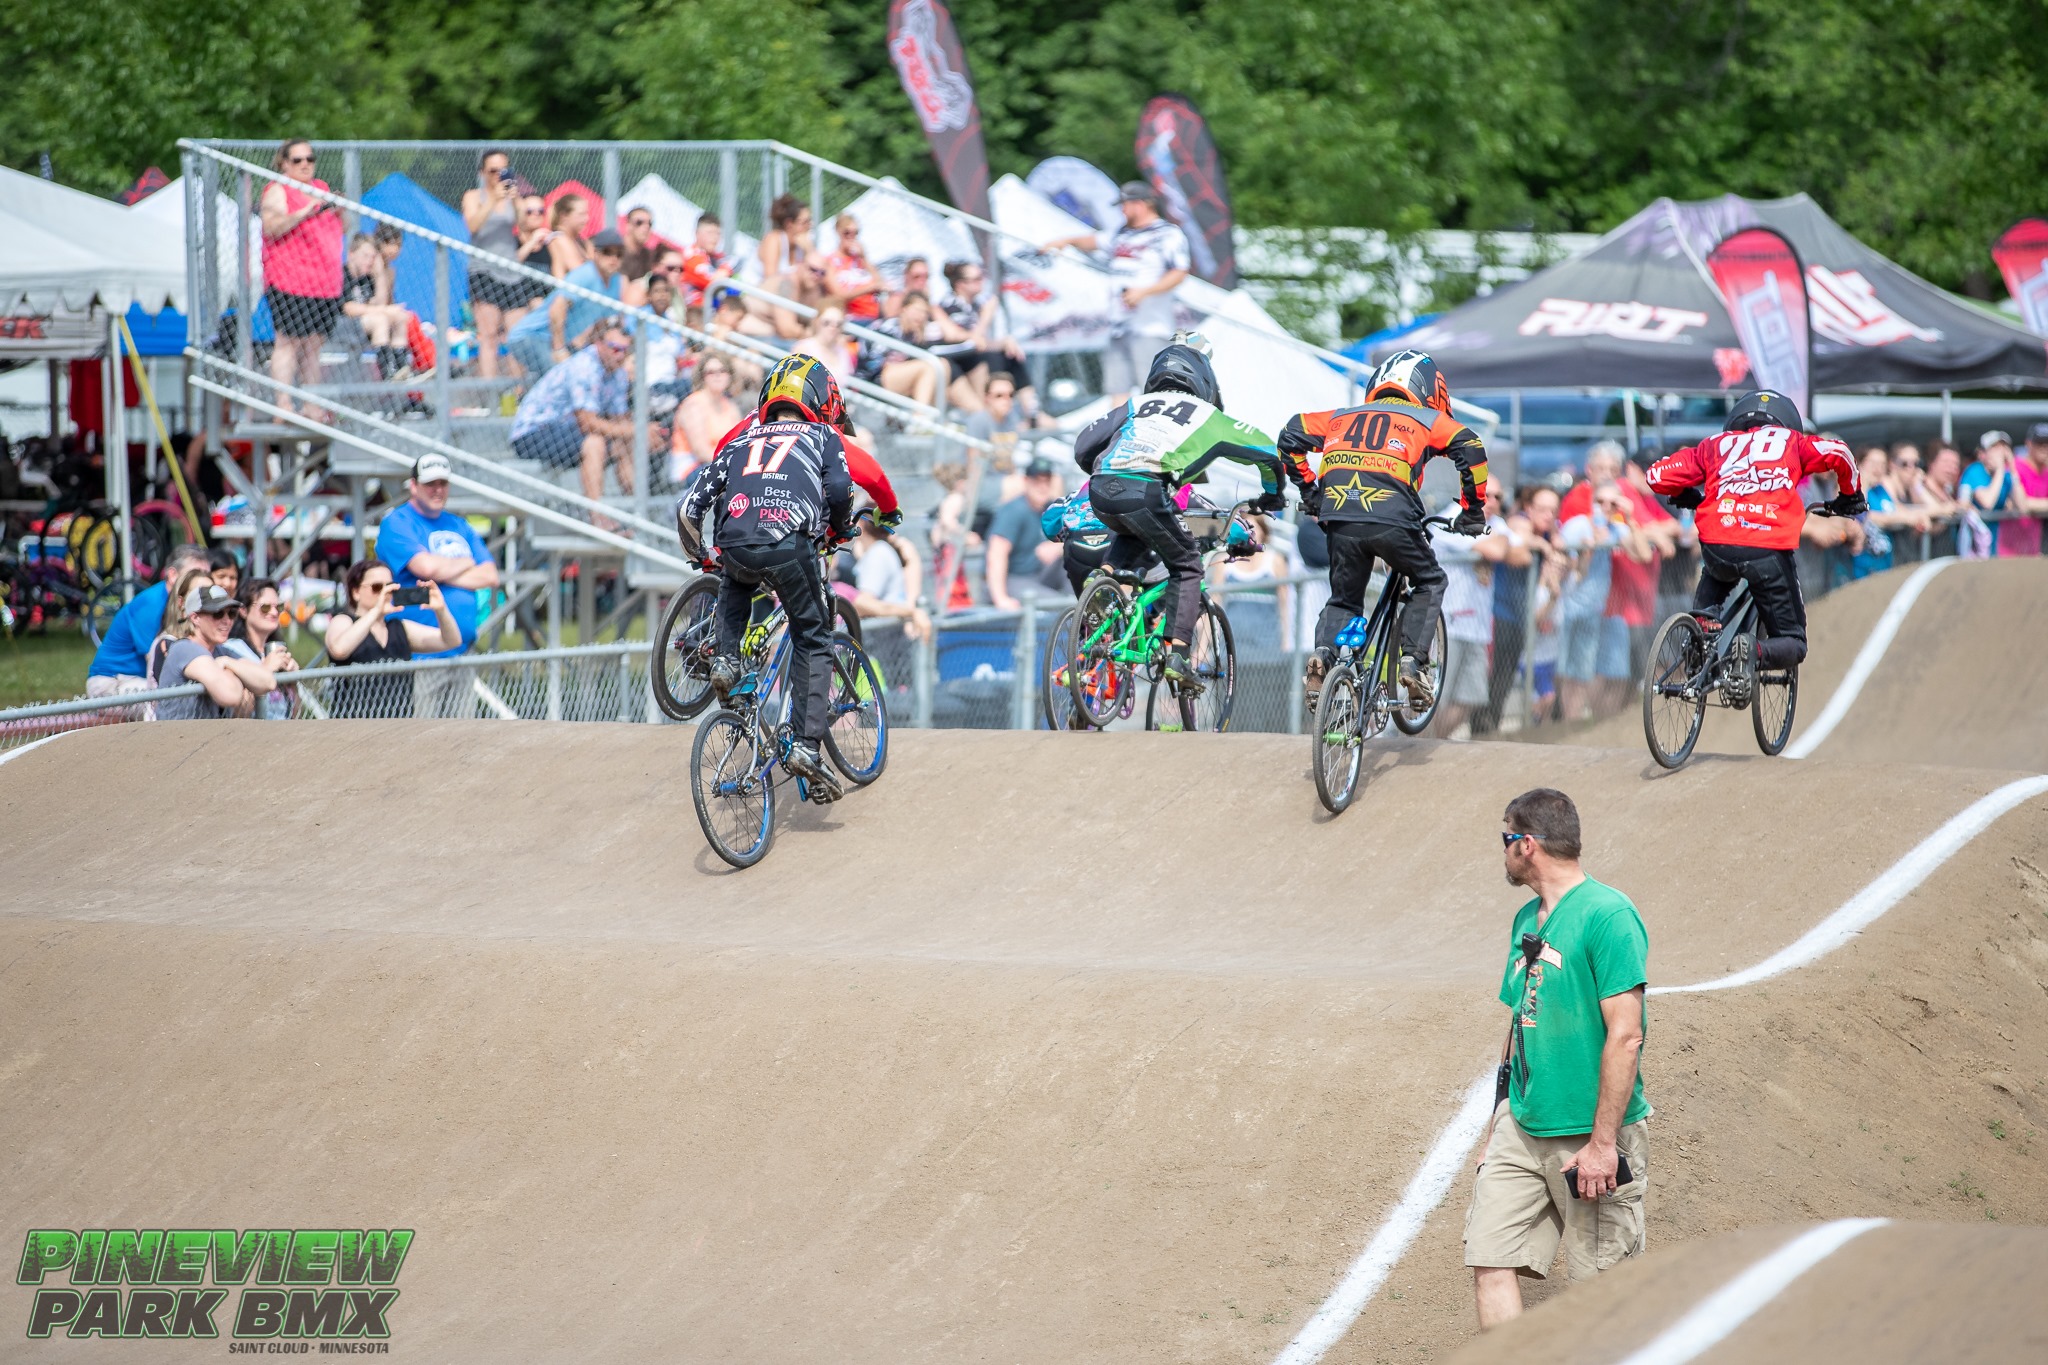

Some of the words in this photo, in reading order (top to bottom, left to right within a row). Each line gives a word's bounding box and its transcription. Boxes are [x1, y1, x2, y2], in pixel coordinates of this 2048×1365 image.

[1519, 298, 1709, 343] RIOT
[1133, 399, 1198, 427] 64
[1343, 413, 1391, 450] 40
[1393, 424, 1415, 434] KALI
[742, 436, 800, 477] 17
[1719, 427, 1792, 477] 28
[762, 473, 788, 481] DISTRICT
[764, 486, 792, 499] Best
[752, 496, 800, 511] Western
[759, 508, 790, 521] PLUS
